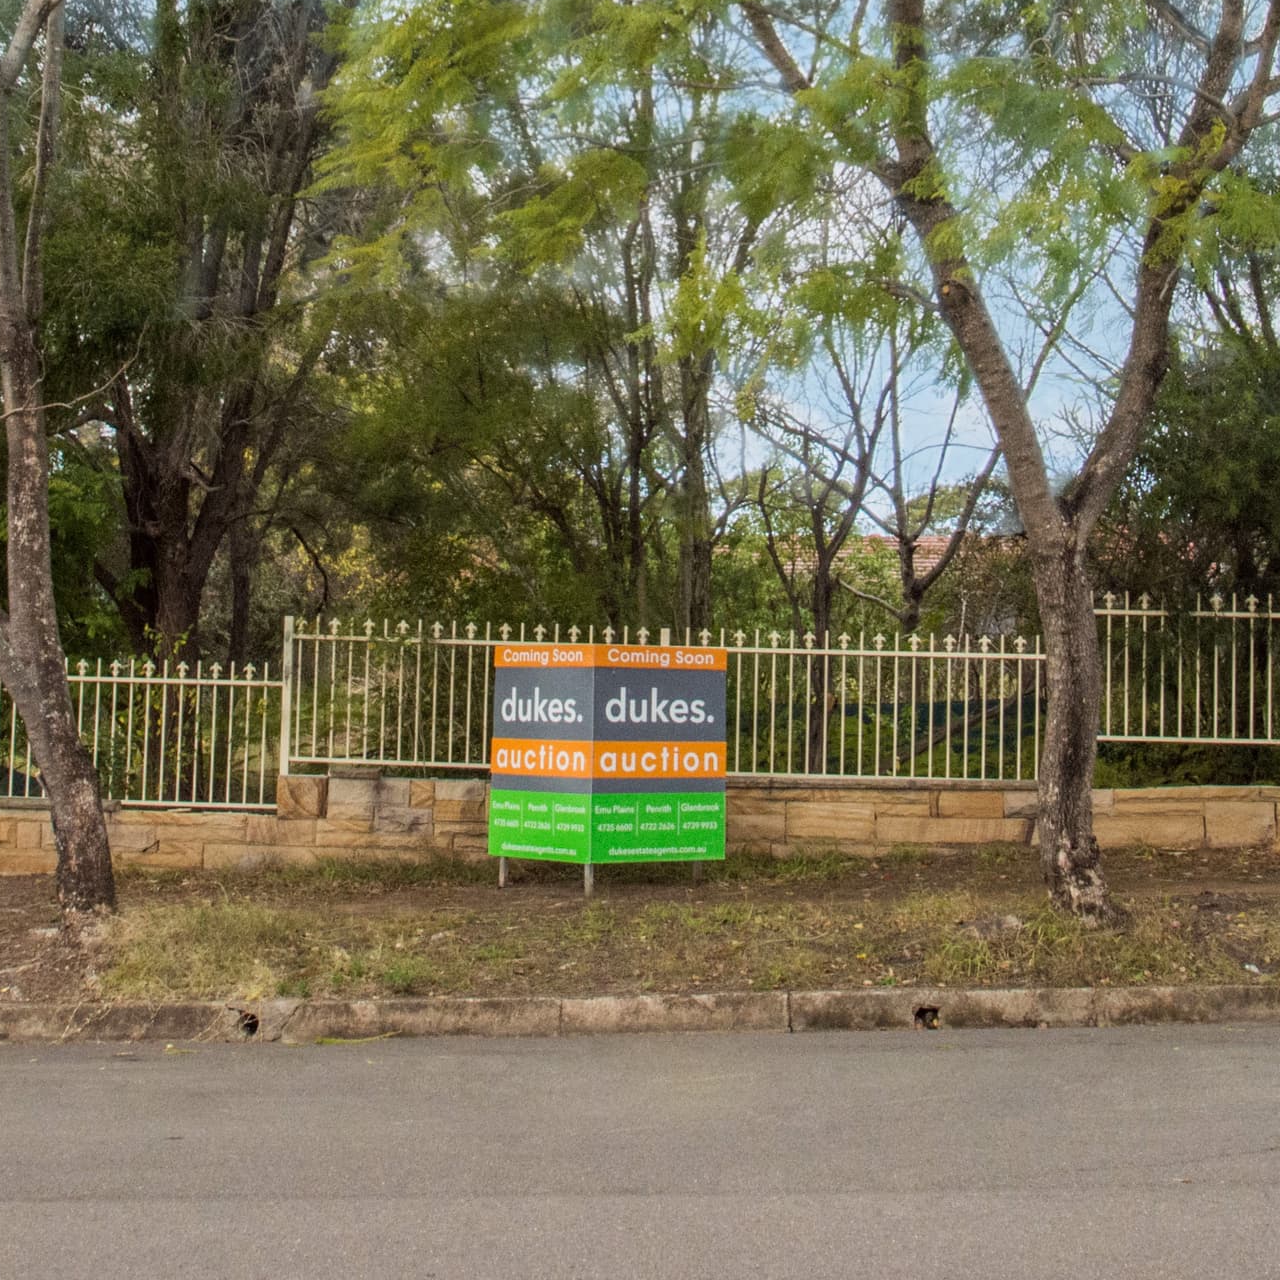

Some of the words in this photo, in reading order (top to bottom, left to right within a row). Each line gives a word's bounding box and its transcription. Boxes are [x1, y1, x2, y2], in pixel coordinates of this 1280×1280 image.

[503, 648, 549, 666] Coming
[552, 648, 583, 662] Soon
[607, 649, 670, 667] Coming
[675, 650, 714, 665] Soon
[501, 686, 583, 723] dukes.
[605, 686, 715, 723] dukes.
[496, 745, 585, 770] auction
[600, 747, 719, 772] auction
[594, 805, 612, 814] Emu
[613, 804, 635, 814] Plains
[645, 804, 672, 813] Penrith
[680, 802, 720, 812] Glenbrook
[608, 846, 707, 856] dukesestateagents.com.au
